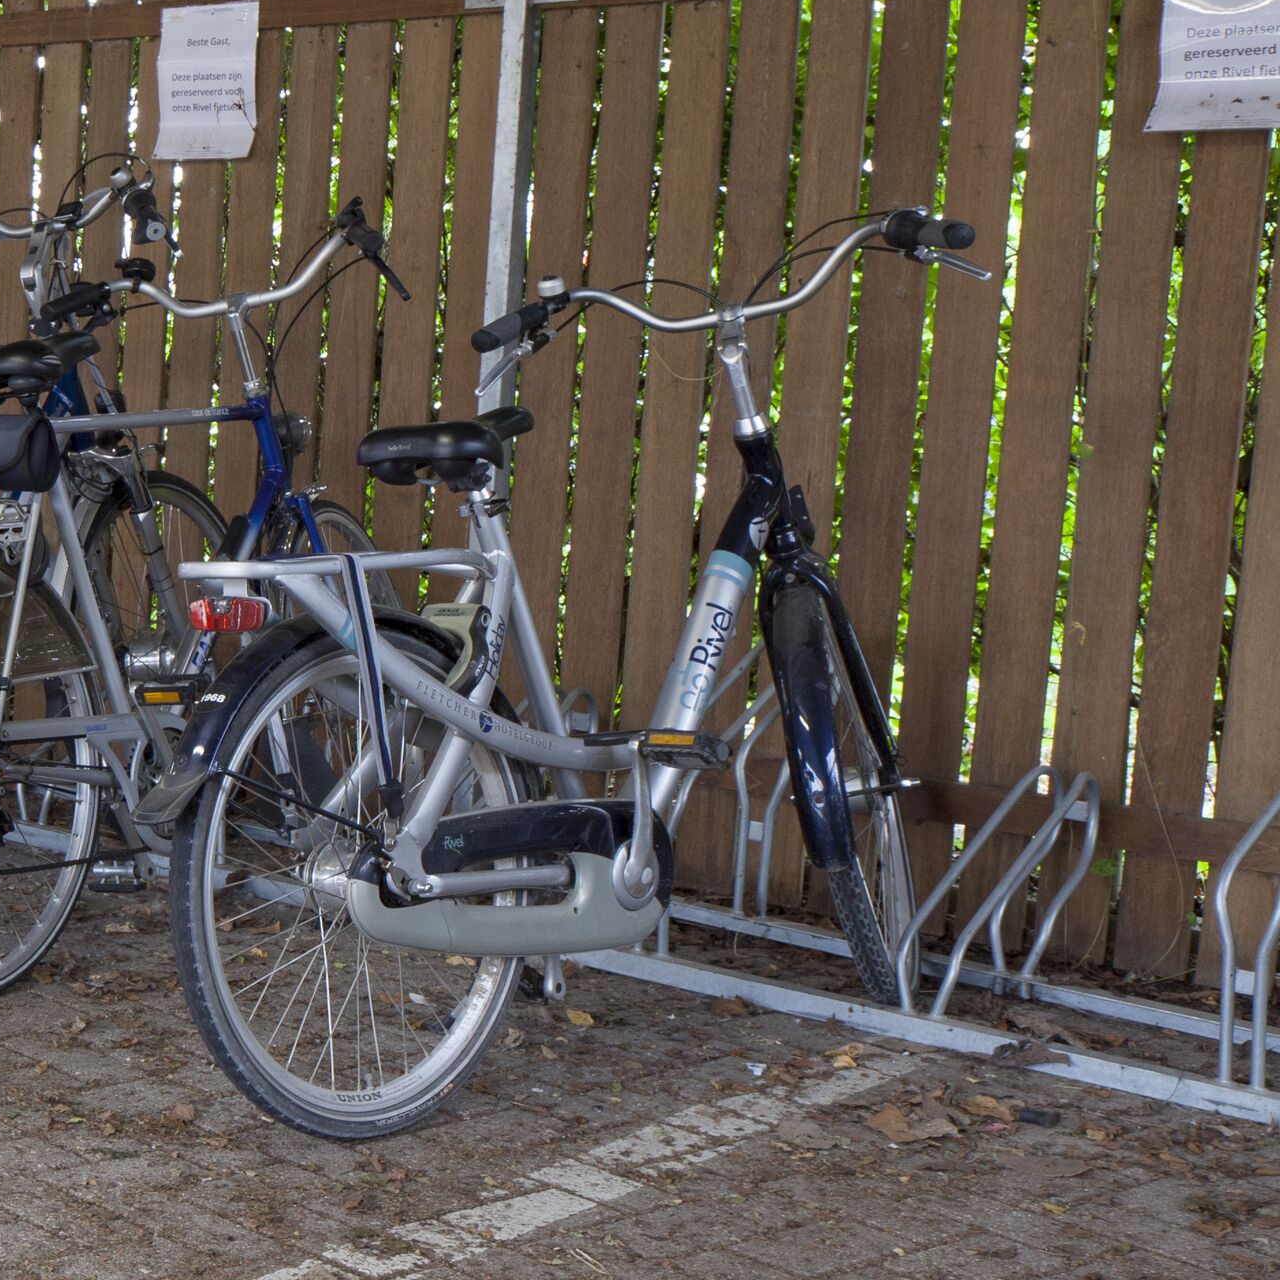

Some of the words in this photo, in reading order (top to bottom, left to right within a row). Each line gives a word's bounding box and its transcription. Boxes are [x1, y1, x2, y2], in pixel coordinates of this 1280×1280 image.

[1186, 27, 1221, 39] Deze
[186, 37, 209, 47] Beste
[1183, 43, 1277, 62] gereserveerd
[171, 73, 192, 82] Deze
[192, 72, 227, 82] plaatsen
[228, 71, 243, 81] zijn
[1184, 69, 1218, 80] onze
[1222, 64, 1257, 79] Rivel
[1260, 64, 1280, 77] fie
[170, 87, 223, 99] gereserveerd
[172, 103, 192, 112] onze
[192, 102, 212, 112] Rivel
[688, 601, 735, 672] Rivel
[485, 614, 506, 681] Holiday
[416, 679, 478, 721] FLETCHER
[443, 832, 465, 849] Rivel
[335, 1090, 383, 1103] UNION
